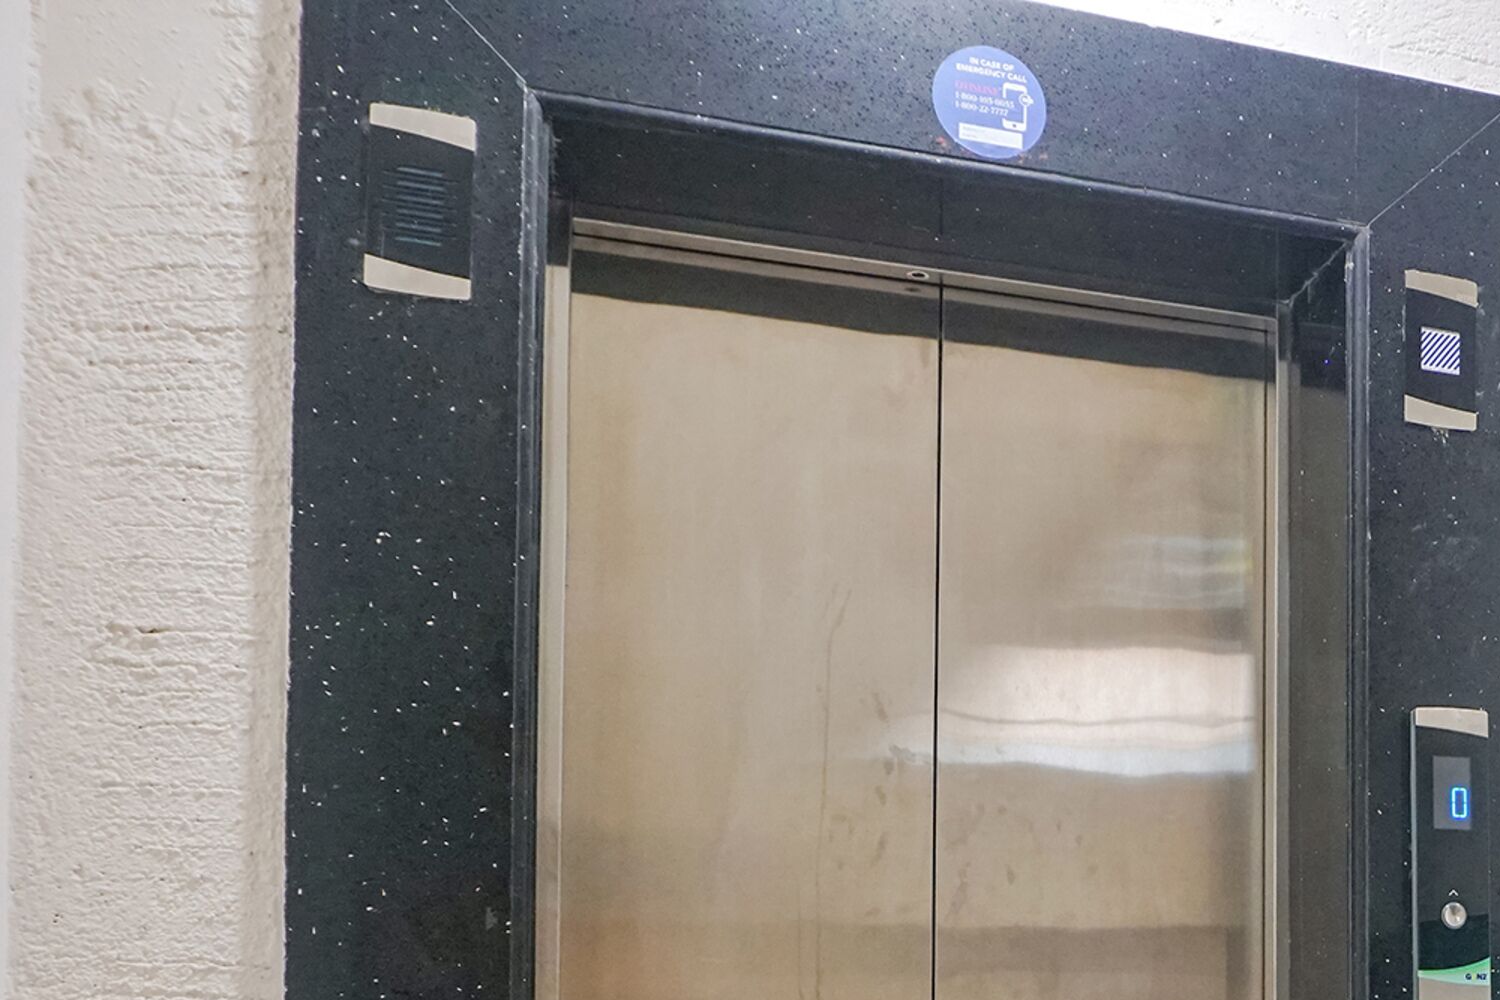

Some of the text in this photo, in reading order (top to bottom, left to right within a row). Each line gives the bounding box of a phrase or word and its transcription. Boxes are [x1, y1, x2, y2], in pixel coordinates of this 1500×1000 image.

[955, 62, 1027, 83] EMERGENCY CALL
[969, 56, 1014, 71] IN CASE OF
[1451, 786, 1468, 818] 0
